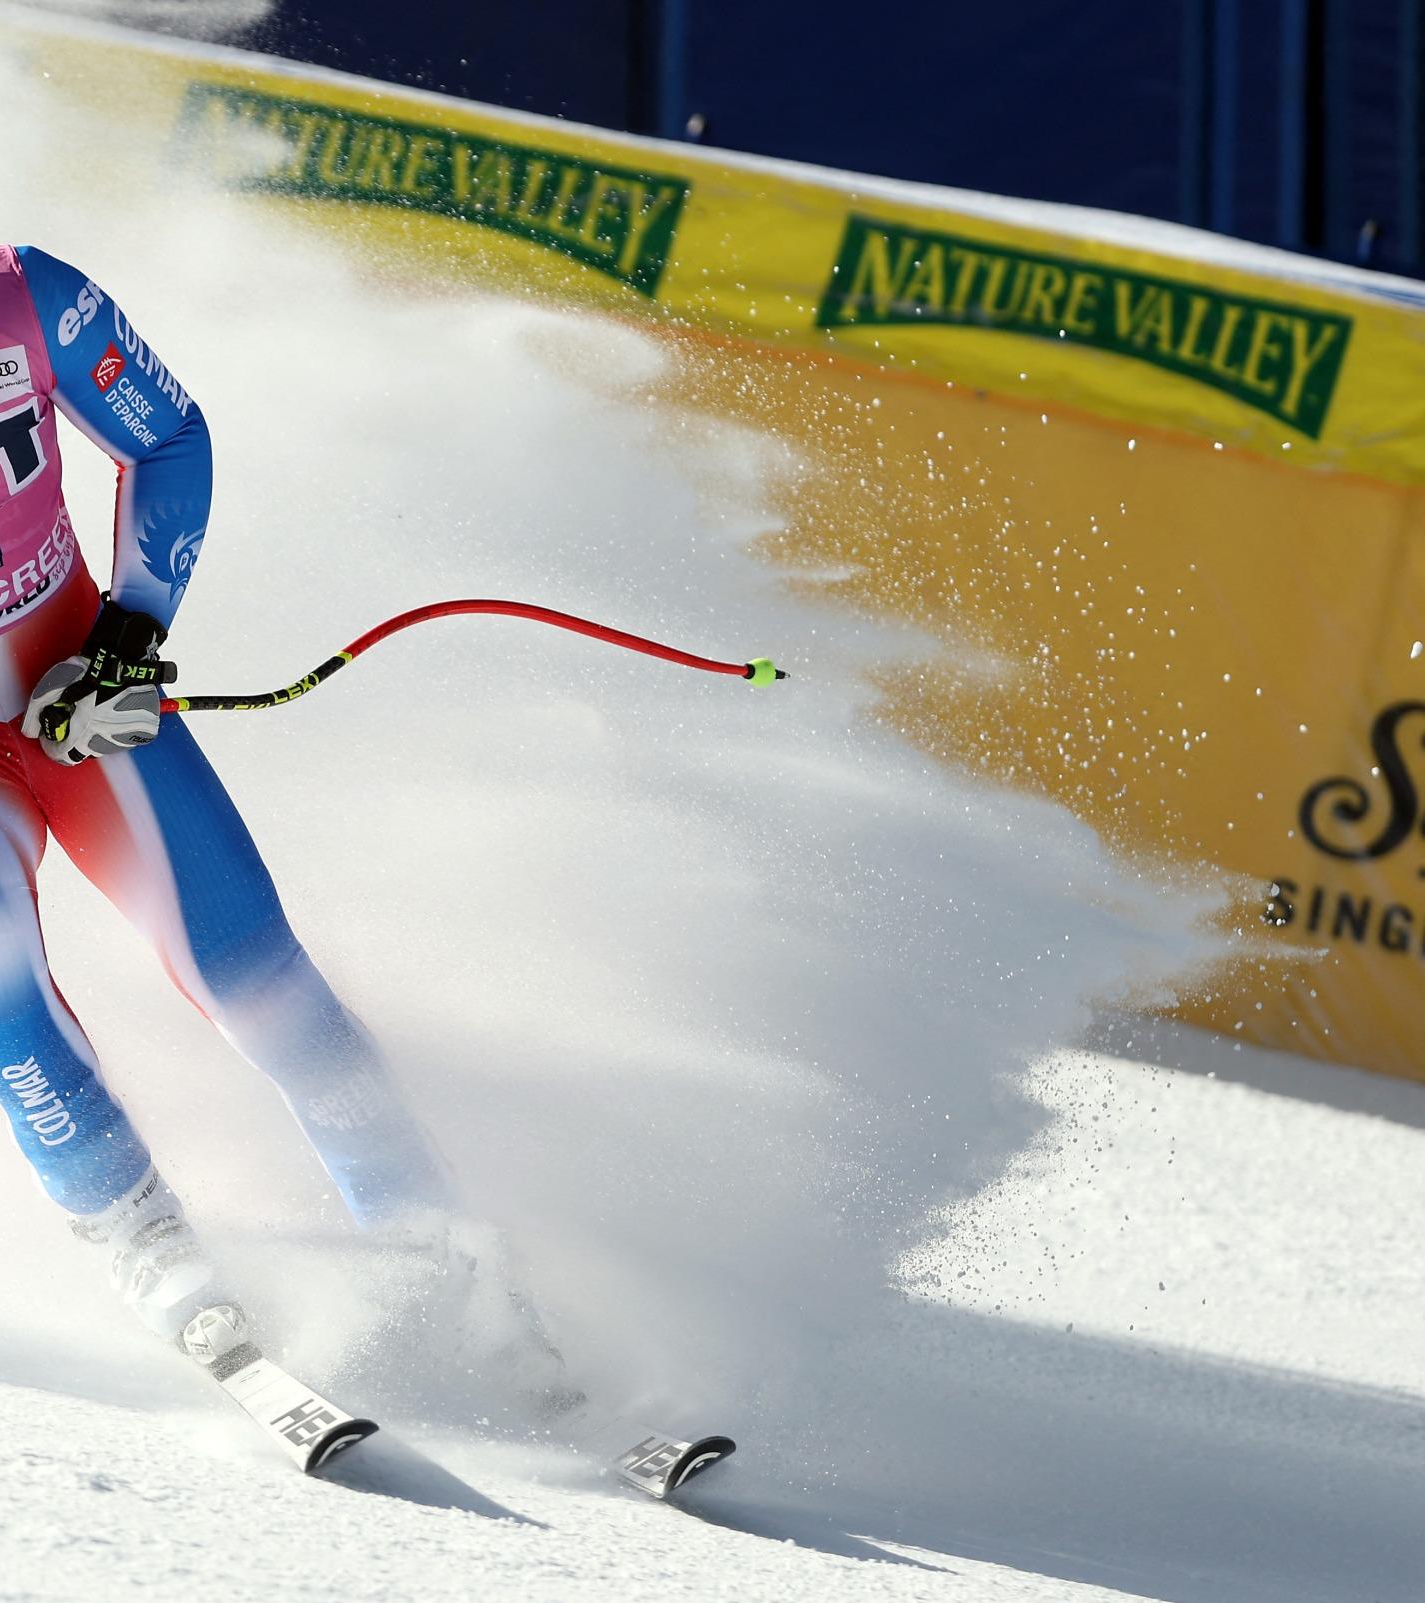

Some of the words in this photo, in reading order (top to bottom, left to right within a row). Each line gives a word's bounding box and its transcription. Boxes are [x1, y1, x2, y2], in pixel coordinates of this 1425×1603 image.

[452, 145, 675, 275] VALLEY
[838, 228, 1110, 335] NATURE
[1100, 279, 1337, 418] VALLEY
[105, 391, 157, 447] D'EPARGNE
[118, 377, 154, 420] CAISSE
[89, 648, 107, 679] LEKI
[122, 664, 157, 680] LEK
[273, 671, 320, 704] LEKI
[1259, 875, 1425, 960] SING
[1, 1055, 77, 1147] COLMAR
